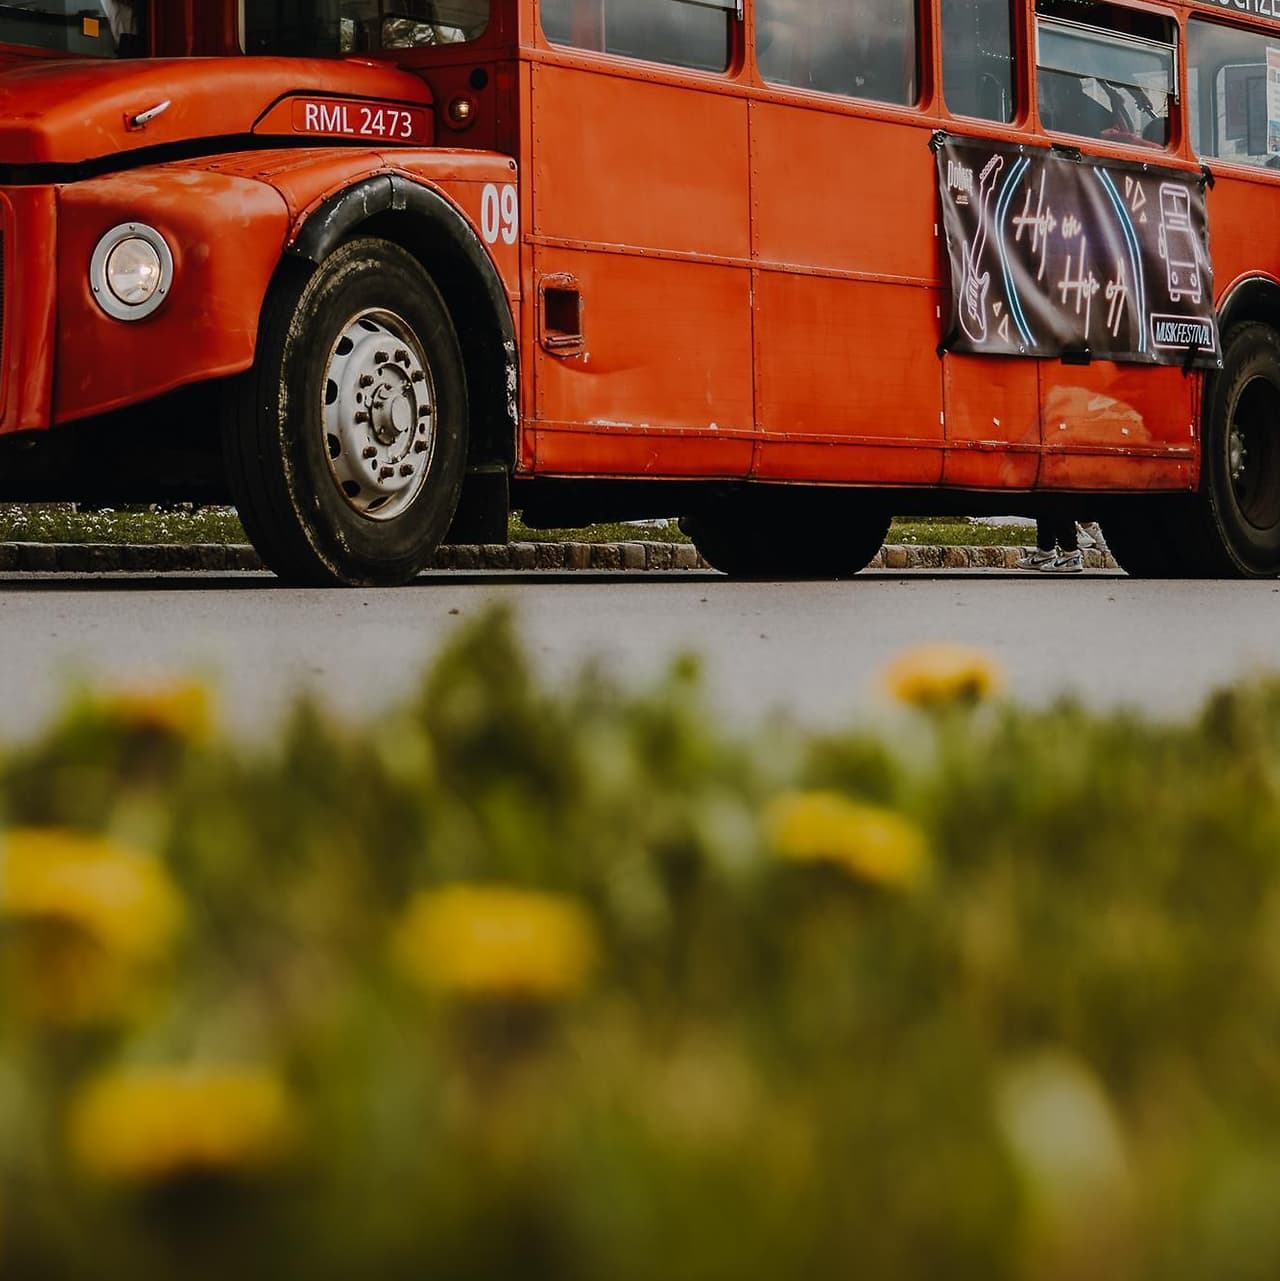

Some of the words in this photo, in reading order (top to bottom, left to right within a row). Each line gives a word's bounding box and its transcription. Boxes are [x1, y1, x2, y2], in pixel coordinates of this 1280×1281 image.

[305, 103, 354, 135] RML
[359, 107, 413, 138] 2473
[480, 183, 519, 245] 09
[1013, 169, 1057, 280] Hop
[1062, 214, 1083, 239] on
[1058, 235, 1101, 340] Hop
[1105, 257, 1129, 338] off
[1156, 322, 1211, 345] MUSIKFESTIVAL
